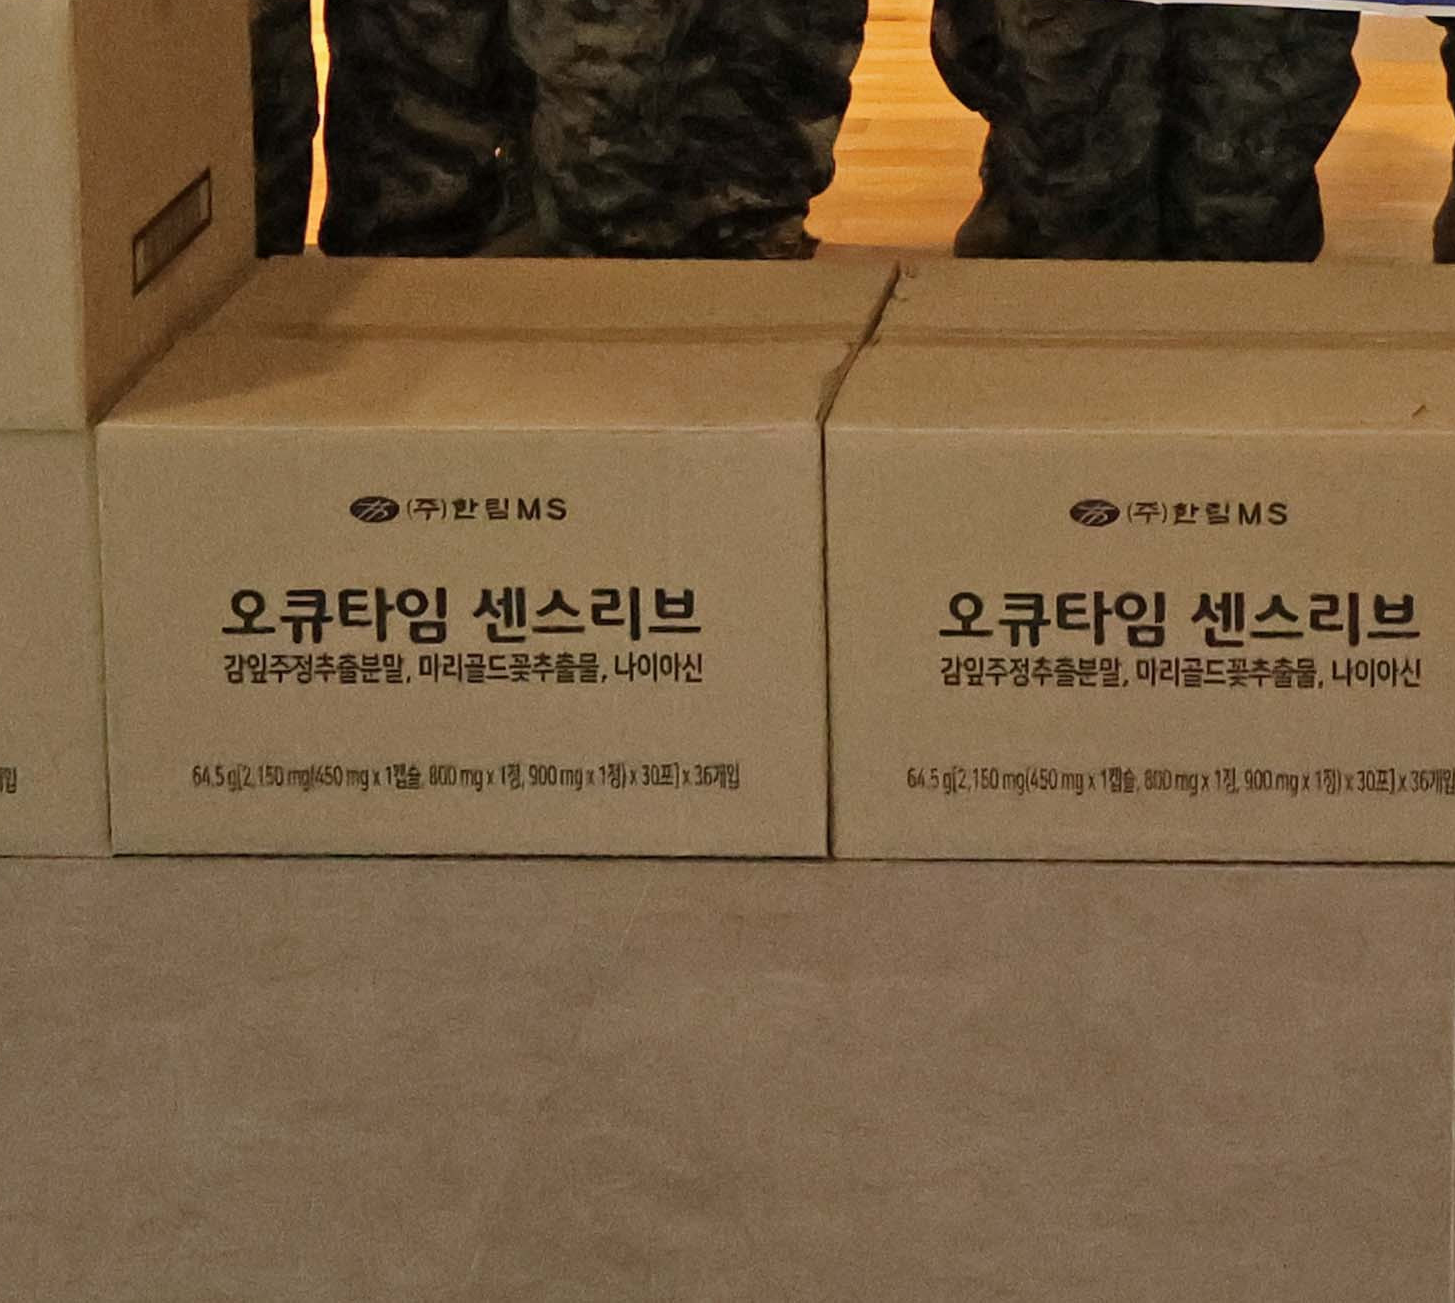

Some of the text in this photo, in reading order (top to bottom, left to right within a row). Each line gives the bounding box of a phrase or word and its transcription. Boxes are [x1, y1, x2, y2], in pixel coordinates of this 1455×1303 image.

[221, 587, 702, 644] 오큐타임 센스리브
[939, 591, 1421, 648] 오큐타임 센스리브
[615, 651, 703, 683] 나이아신
[1332, 657, 1421, 689] 나이아신
[346, 769, 369, 792] mg
[460, 769, 483, 792] mg
[560, 769, 583, 792] mg
[1061, 773, 1084, 796] mg
[1175, 773, 1198, 796] mg
[1275, 773, 1298, 796] mg
